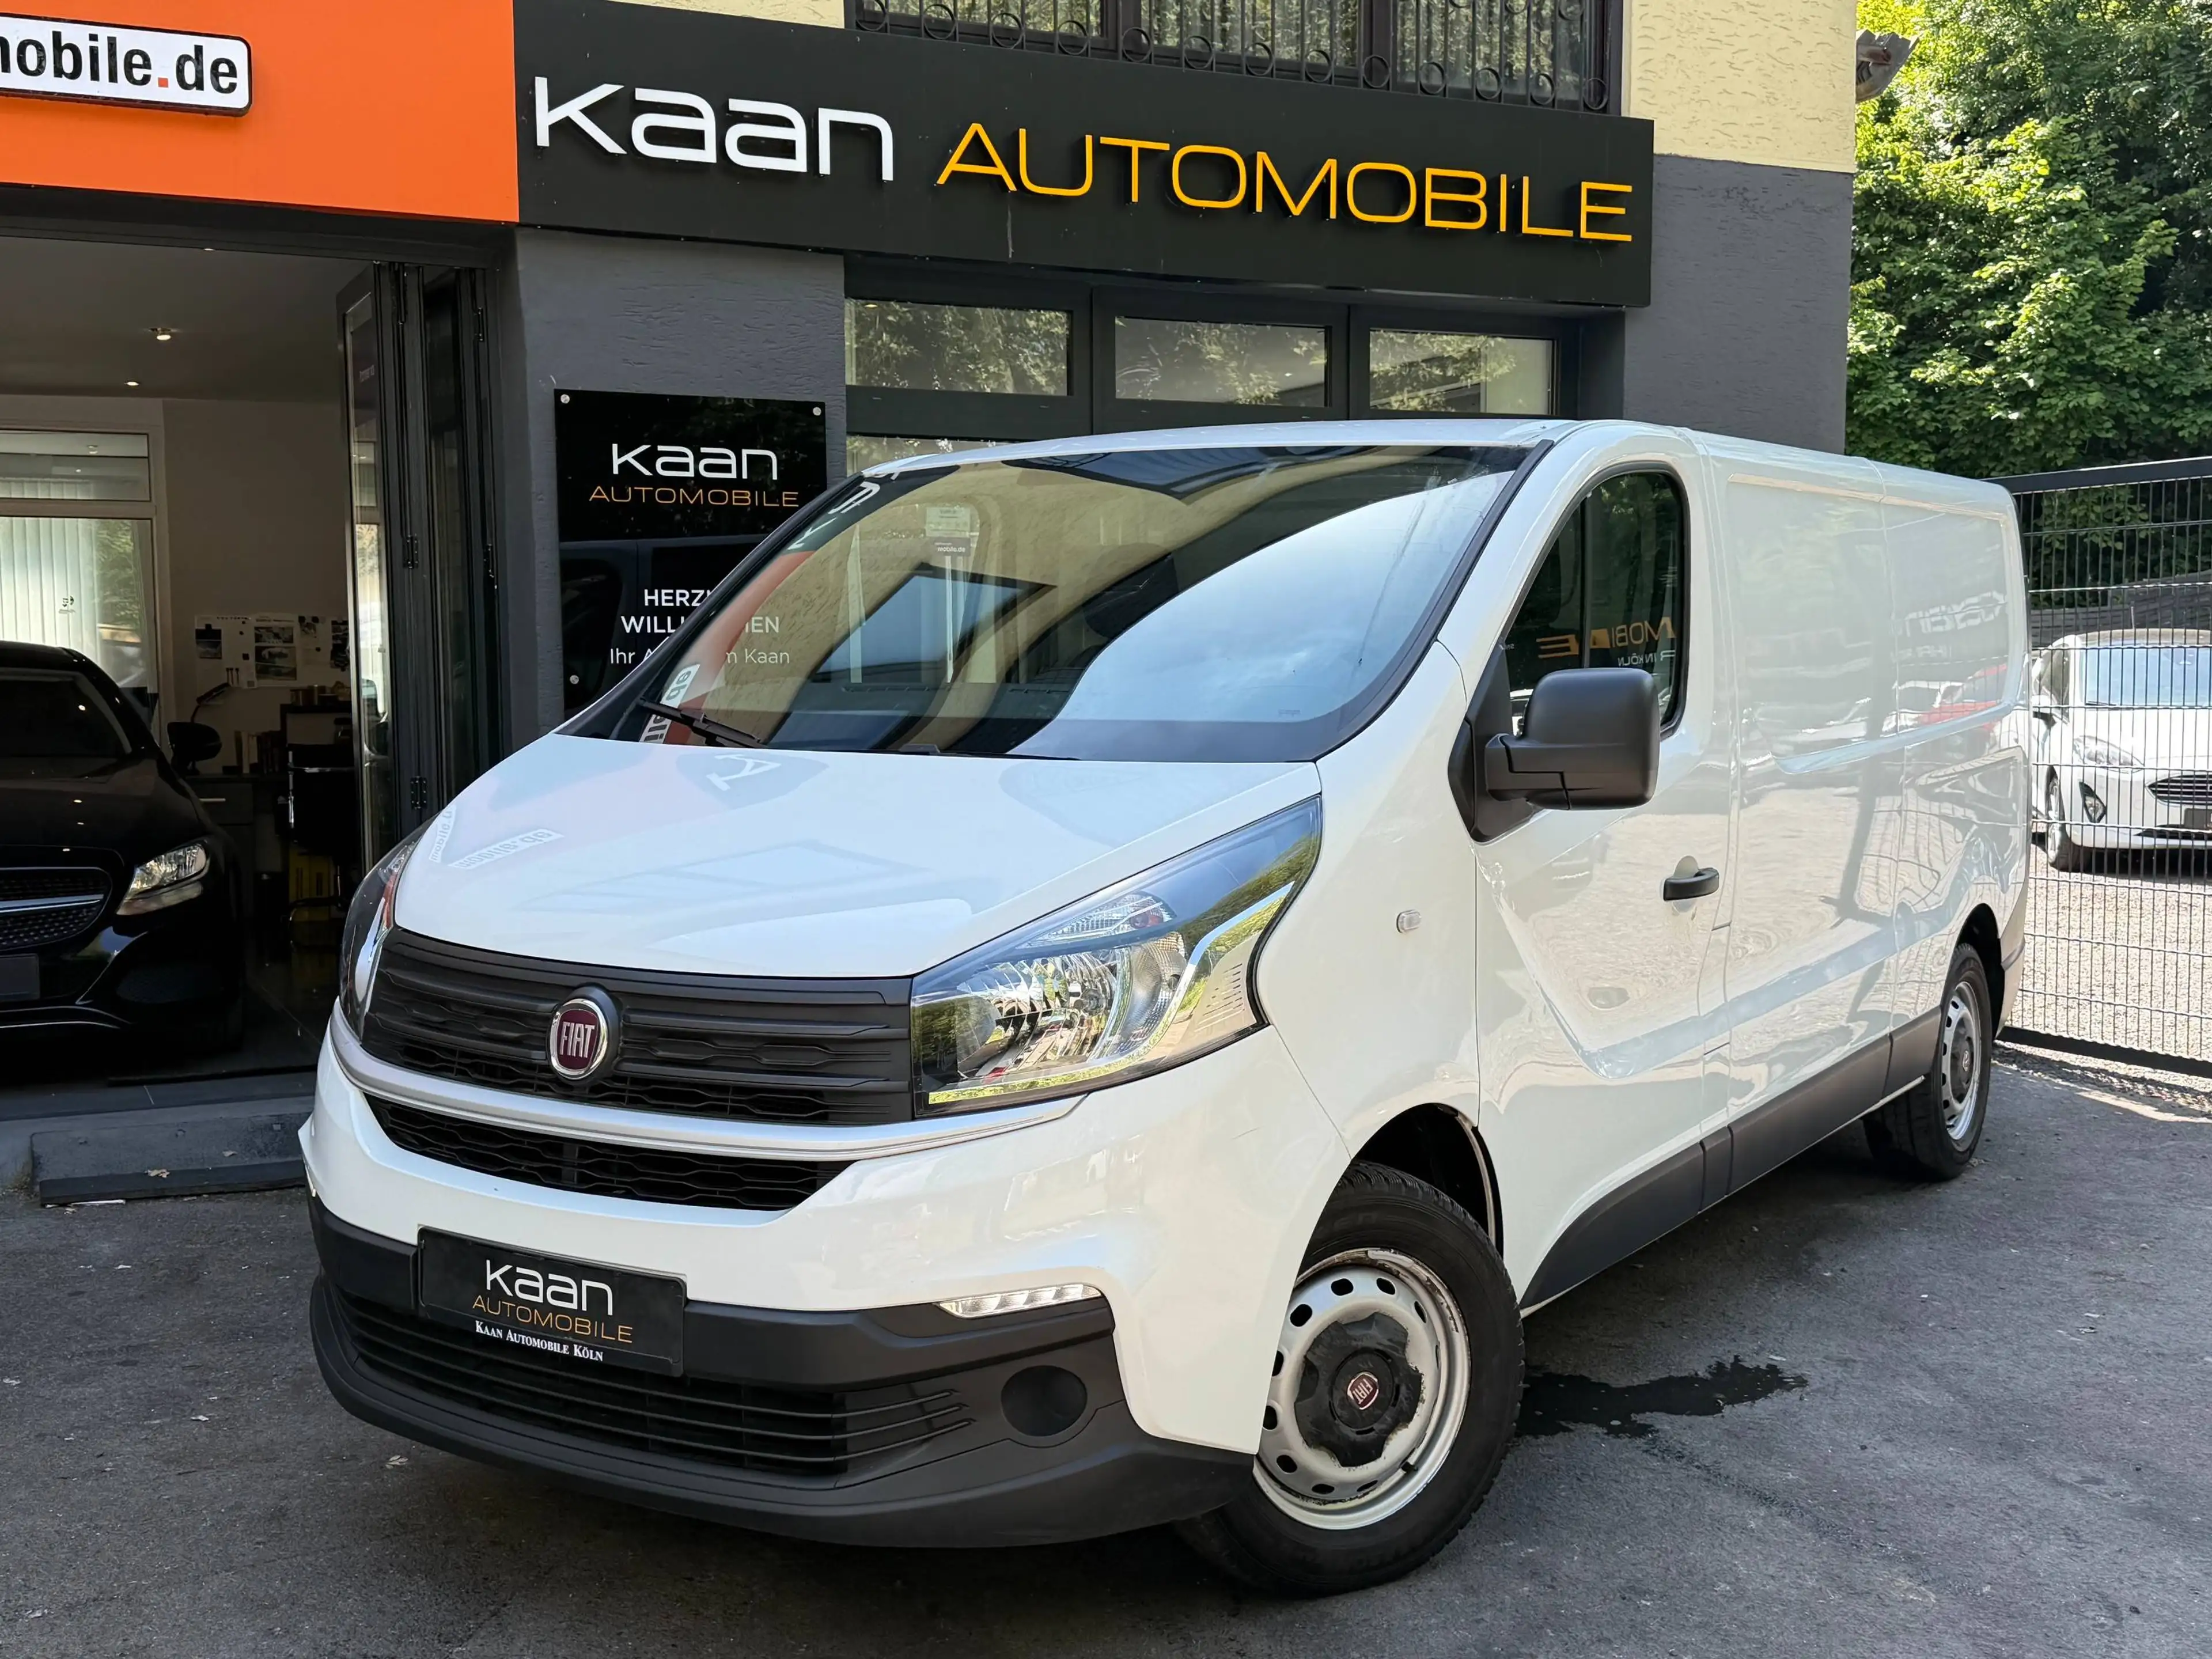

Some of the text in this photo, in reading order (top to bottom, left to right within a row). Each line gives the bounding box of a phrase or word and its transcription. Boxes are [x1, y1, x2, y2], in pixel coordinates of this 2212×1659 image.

[0, 31, 238, 94] obile.de
[937, 122, 1633, 242] AUTOMOBILE
[589, 486, 799, 507] AUTOMOBILE
[644, 589, 711, 607] HERZ
[620, 615, 779, 634] WILLEN
[611, 647, 635, 664] Ihr
[745, 647, 790, 664] Kaan
[559, 1021, 596, 1059] FIAT
[472, 1295, 633, 1343] AUTOMOBILE
[1351, 1378, 1373, 1404] FIAT
